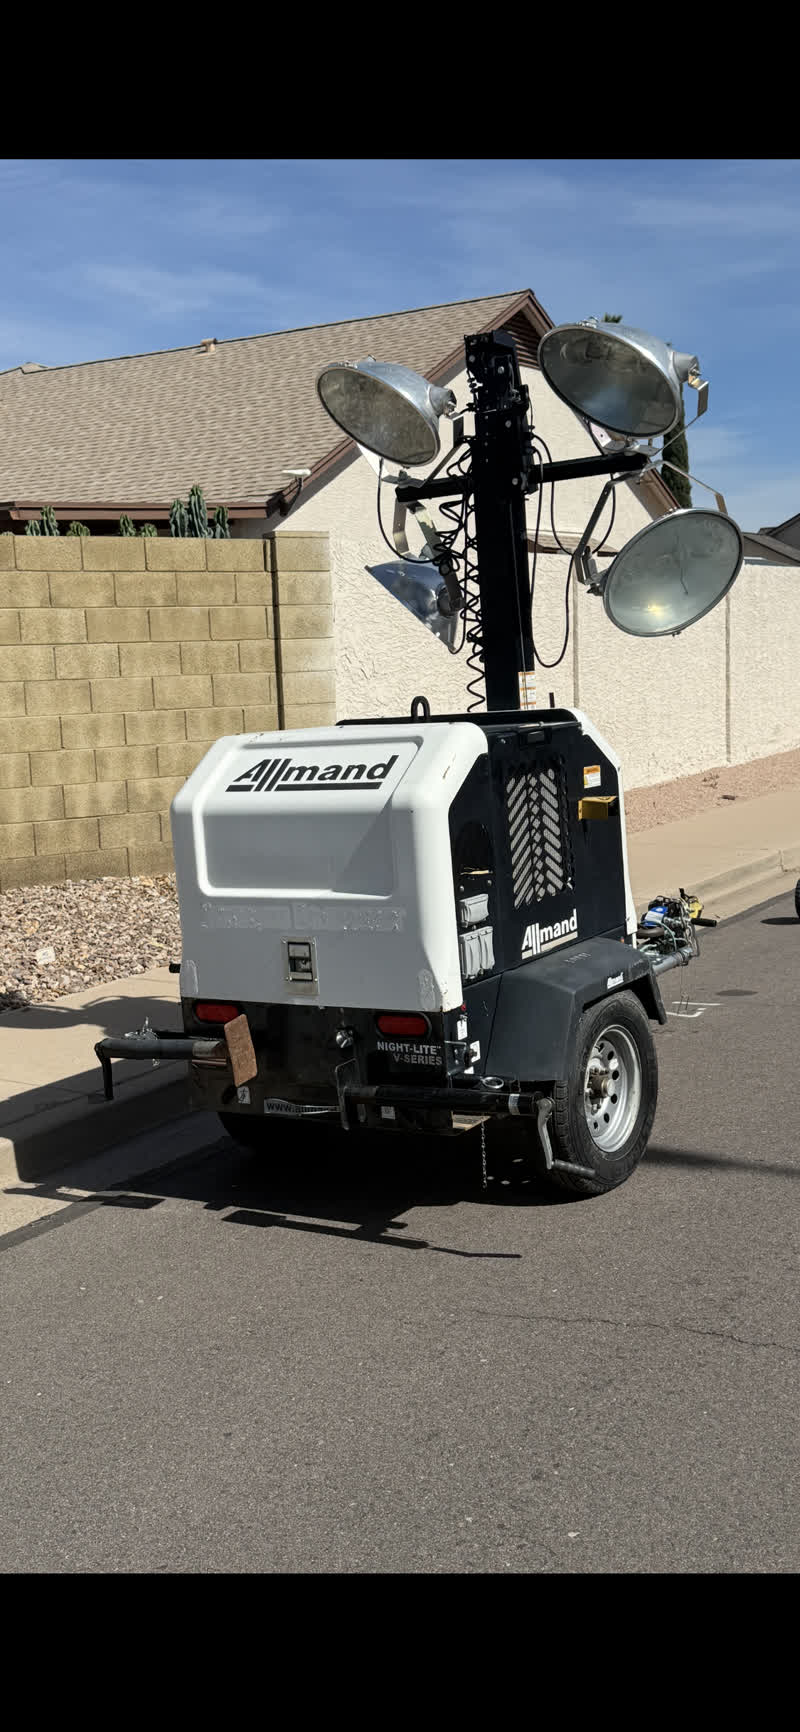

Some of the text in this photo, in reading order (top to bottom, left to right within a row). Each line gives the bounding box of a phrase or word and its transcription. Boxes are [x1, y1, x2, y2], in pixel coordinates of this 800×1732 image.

[229, 755, 399, 792] Allmand
[521, 908, 578, 957] Allmand
[392, 1053, 442, 1066] V-SERIES
